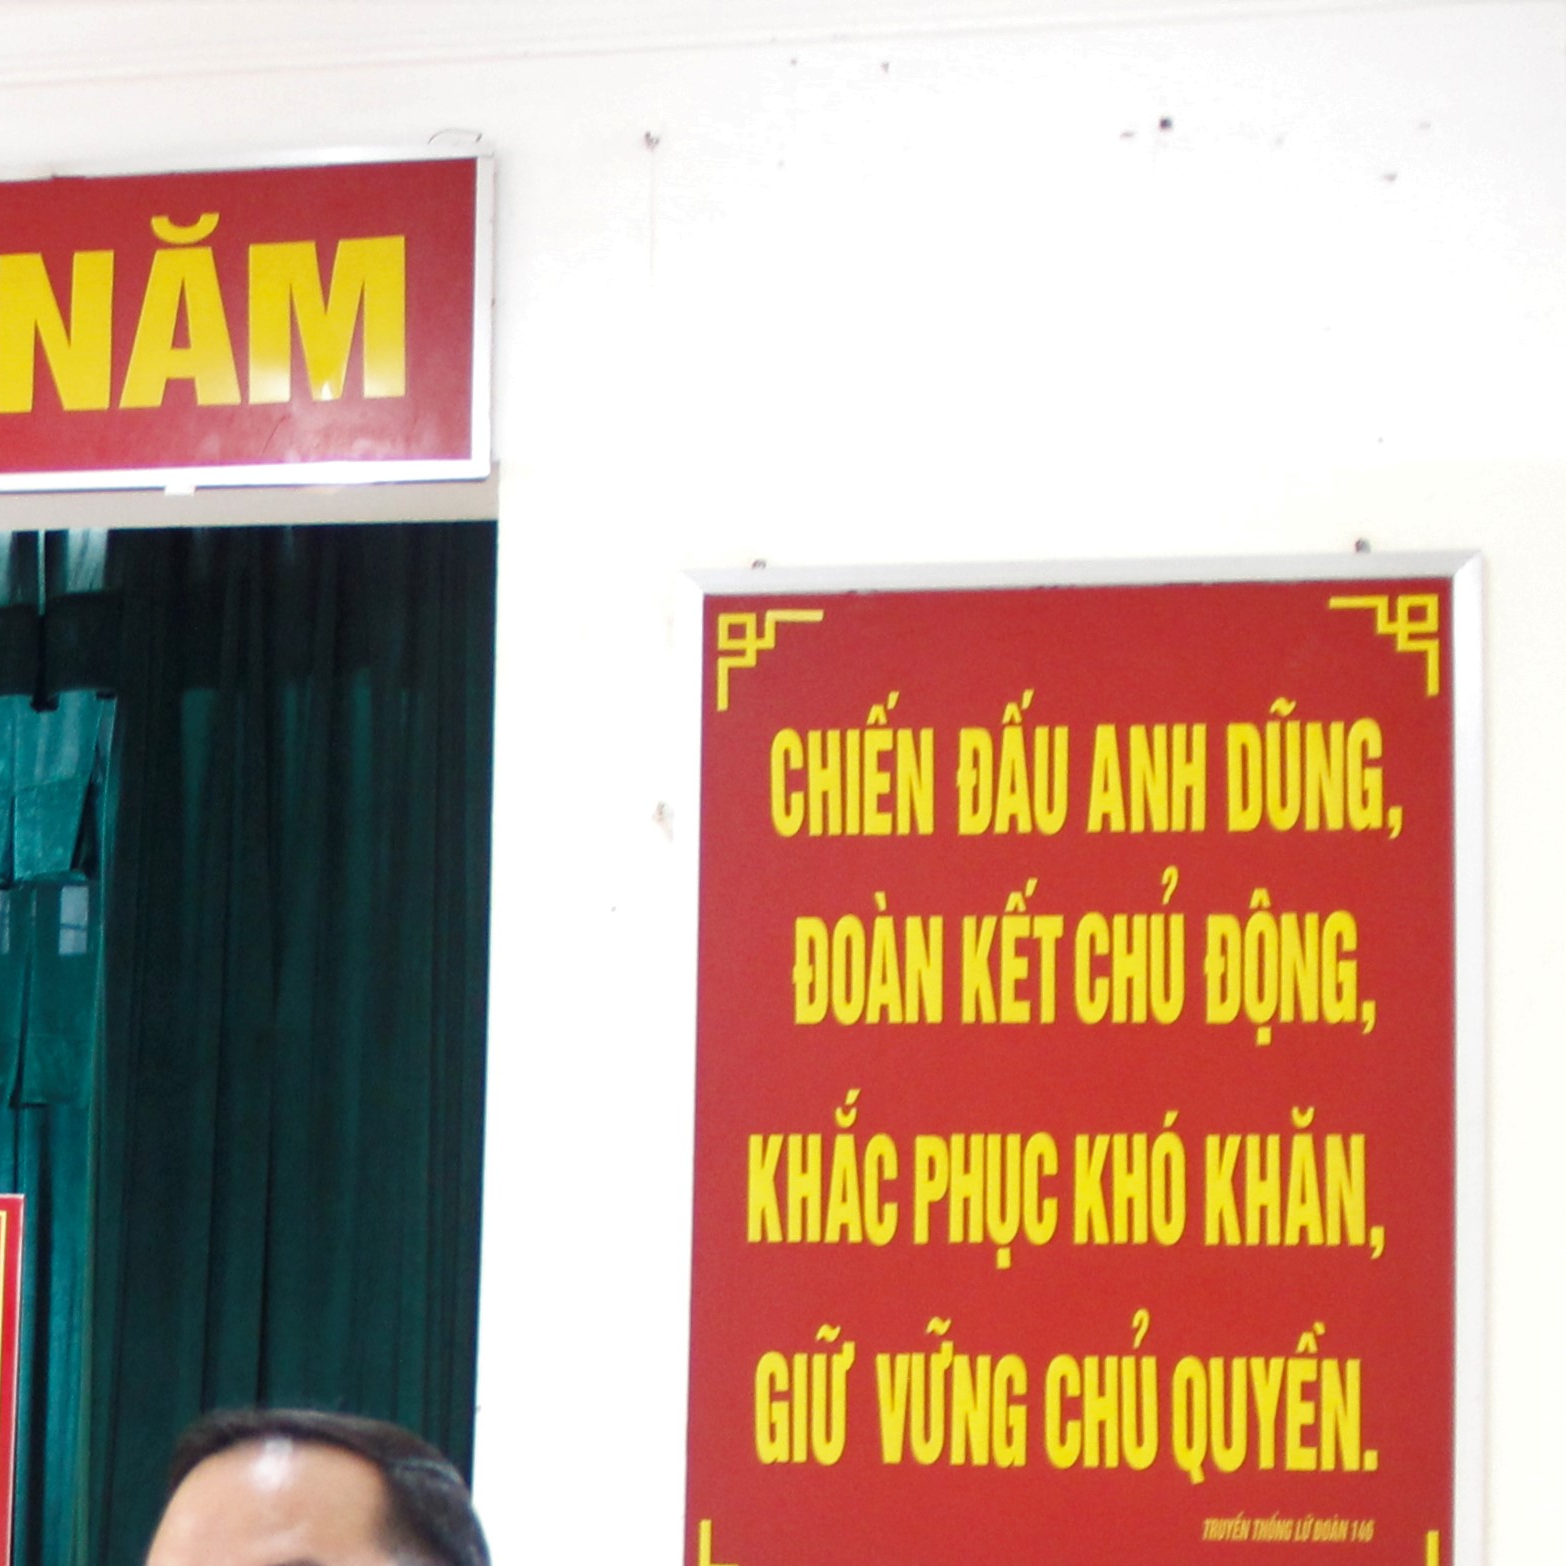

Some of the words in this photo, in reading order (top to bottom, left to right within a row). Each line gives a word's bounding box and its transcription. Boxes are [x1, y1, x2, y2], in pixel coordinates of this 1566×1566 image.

[770, 691, 934, 837] CHIẾN
[956, 689, 1069, 836] ĐẤU
[1087, 723, 1207, 833] ANH
[1226, 697, 1403, 839] DŨNG,
[792, 891, 944, 1026] ĐOÀN
[961, 878, 1064, 1024] KẾT
[1074, 865, 1185, 1025] CHỦ
[1203, 888, 1376, 1046] ĐỘNG,
[747, 1089, 898, 1246] KHẮC
[913, 1131, 1058, 1269] PHỤC
[1073, 1110, 1186, 1246] KHÓ
[1204, 1106, 1385, 1259] KHĂN,
[754, 1324, 855, 1466] GIỮ
[875, 1316, 1027, 1468] VỮNG
[1044, 1308, 1159, 1470] CHỦ
[1171, 1321, 1378, 1485] QUYỀN.
